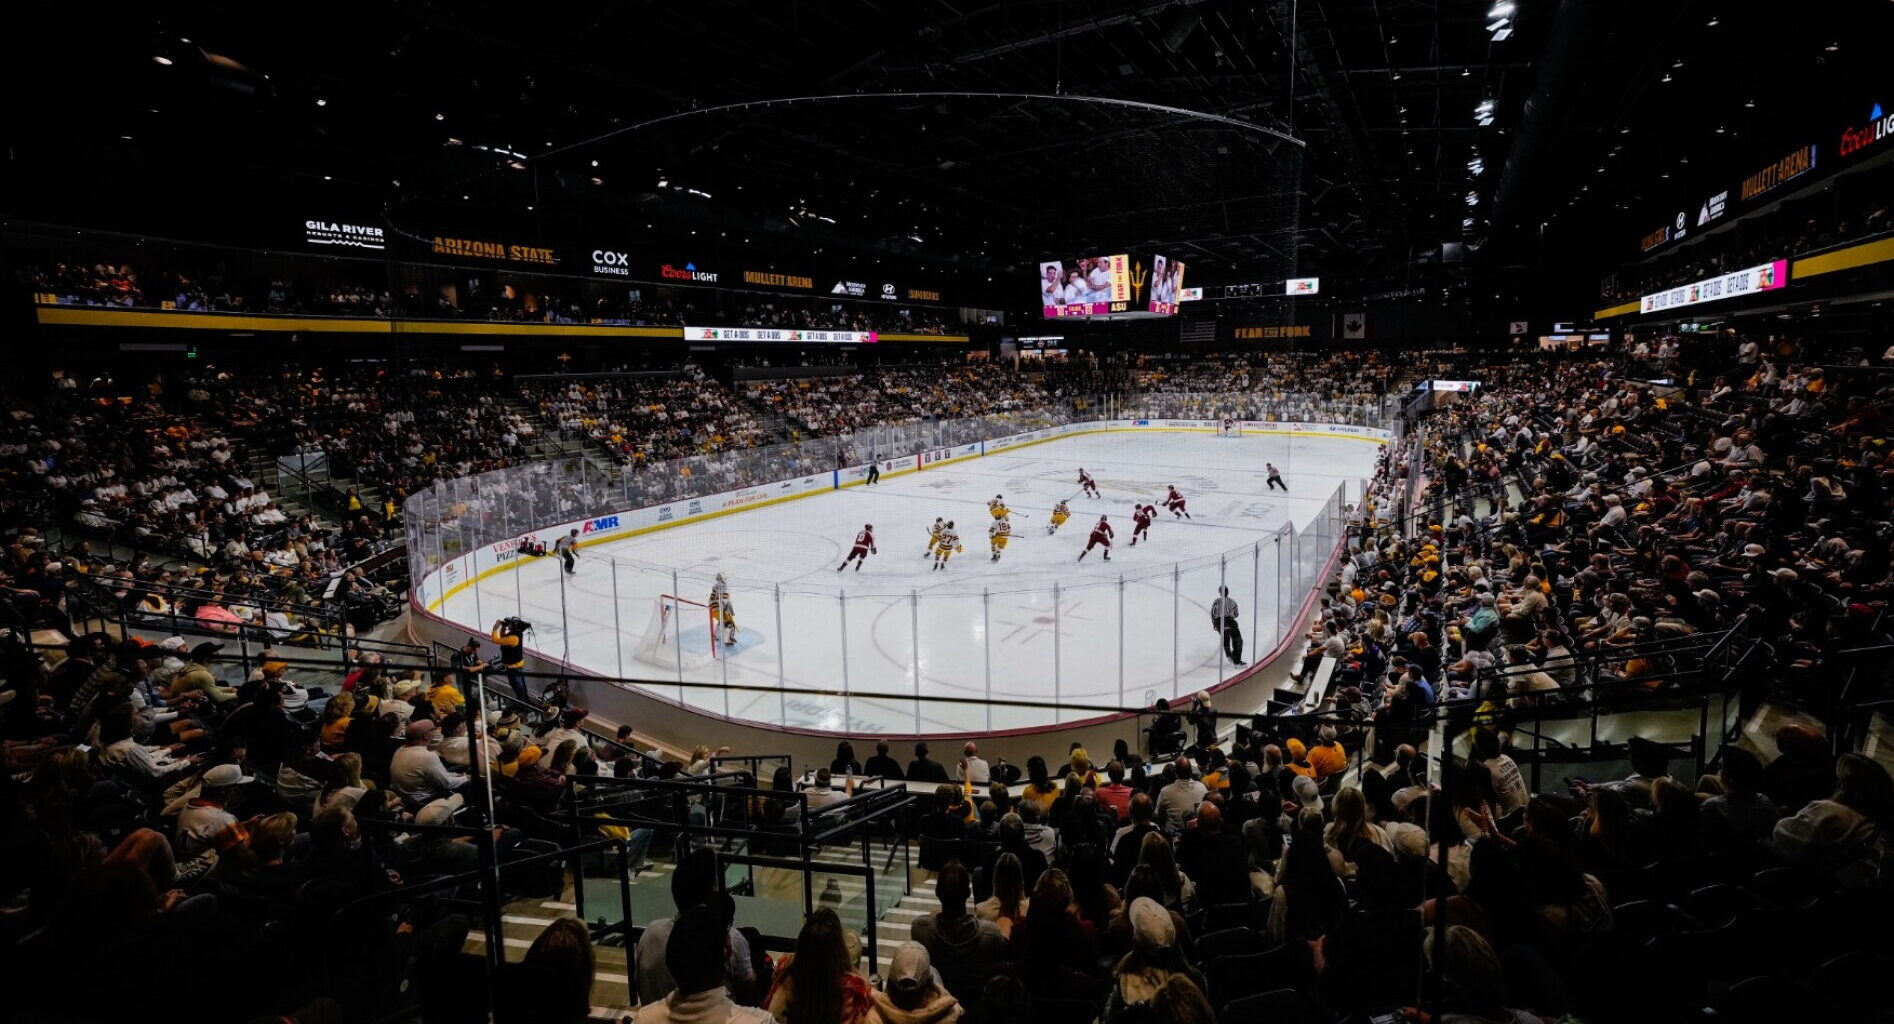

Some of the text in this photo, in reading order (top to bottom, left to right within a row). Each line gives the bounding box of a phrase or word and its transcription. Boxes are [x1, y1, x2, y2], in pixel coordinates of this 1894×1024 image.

[1840, 122, 1876, 158] Coors
[1741, 162, 1777, 200] MULLETT
[1779, 144, 1810, 181] ARENA
[306, 220, 384, 237] GILA RIVER
[432, 236, 556, 264] ARIZONA STATE
[592, 250, 629, 267] COX
[594, 266, 629, 276] BUSINESS
[661, 264, 719, 283] Coors LIGHT
[744, 271, 813, 289] MULLETT ARENA
[1111, 303, 1127, 312] ASU
[1234, 328, 1263, 339] FEAR
[1280, 326, 1311, 337] FORK
[583, 516, 620, 534] AMR
[998, 522, 1008, 531] 18
